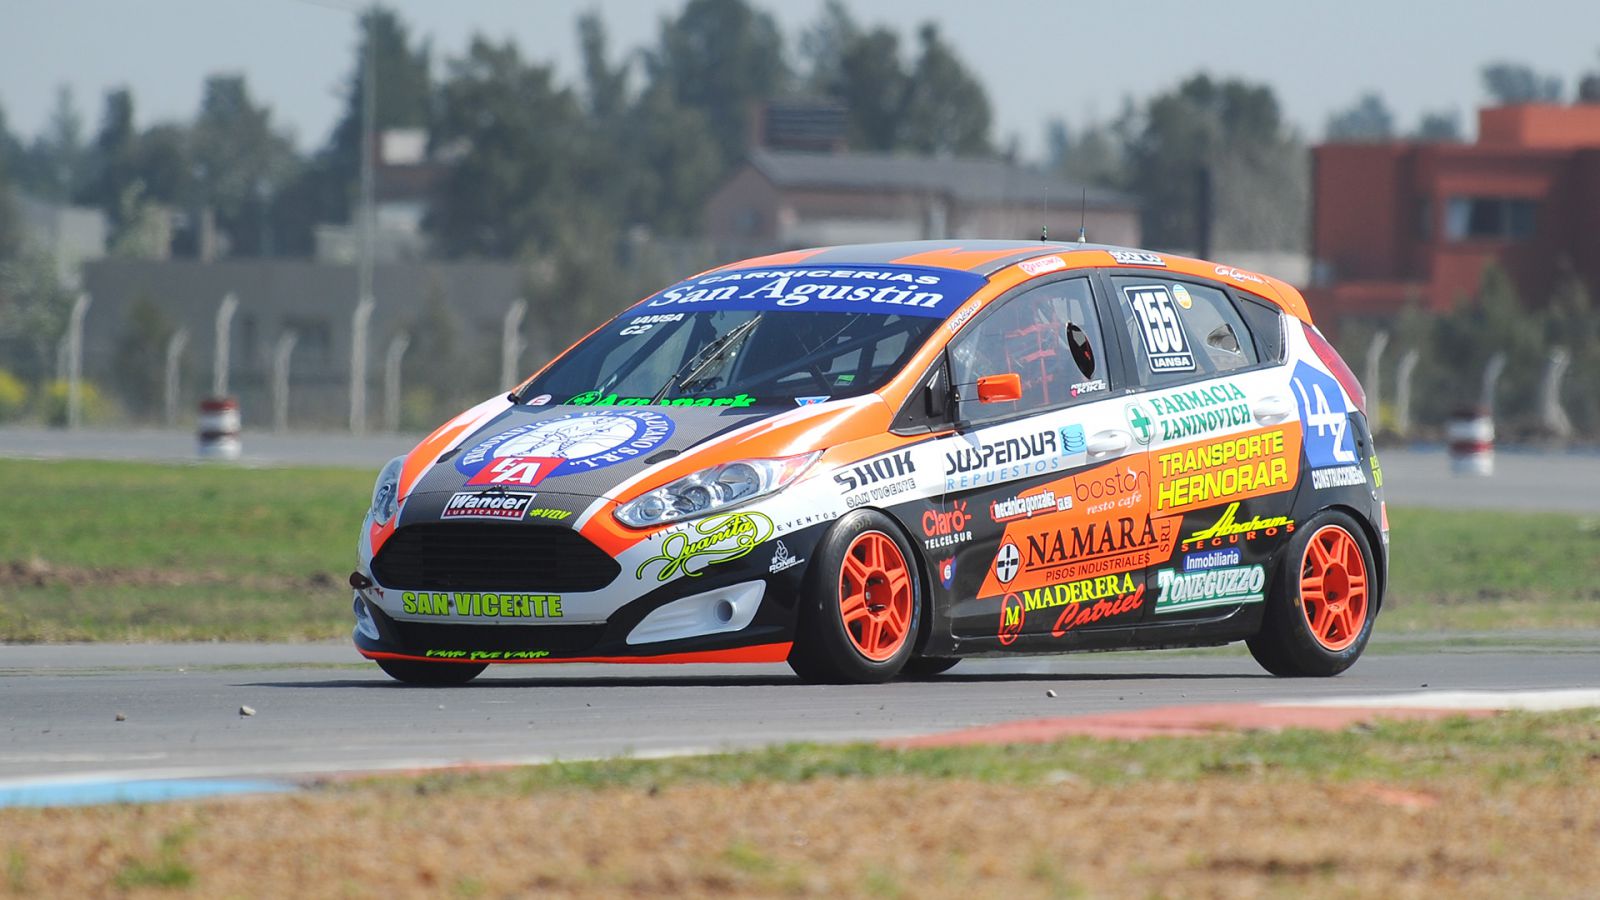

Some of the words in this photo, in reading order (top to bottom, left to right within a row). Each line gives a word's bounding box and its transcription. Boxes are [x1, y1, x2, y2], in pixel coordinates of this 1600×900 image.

[647, 284, 742, 308] San
[739, 276, 944, 309] Agustin
[698, 270, 943, 285] CARNICERIAS
[618, 325, 652, 337] C2
[630, 312, 685, 325] IANSA
[1132, 290, 1184, 353] 155
[1153, 356, 1191, 369] IANSA
[1150, 382, 1248, 416] FARMACIA
[1161, 403, 1252, 442] ZANINOVICH
[945, 430, 1057, 476] SUSPENSUR
[1158, 430, 1285, 478] TRANSPORTE
[833, 450, 916, 495] SHOK
[946, 457, 1060, 491] REPUESTOS
[1073, 466, 1151, 502] boston
[1157, 457, 1289, 511] HERNORAR
[449, 494, 527, 511] Wander
[845, 492, 871, 508] SAN
[870, 477, 917, 501] VICENTE
[1086, 498, 1116, 515] resto
[447, 509, 522, 518] LUBRICANTES
[776, 511, 839, 532] EVENTOS
[922, 505, 967, 537] Claro
[1182, 501, 1295, 545] Abraham
[635, 510, 774, 582] Juanita
[645, 521, 697, 541] VILLA
[924, 530, 973, 550] TELCELSUR
[1025, 512, 1159, 568] NAMARA
[1160, 519, 1172, 553] SRL
[1180, 523, 1296, 552] SEGUROS
[1045, 566, 1076, 582] PISOS
[1077, 552, 1152, 575] INDUSTRIALES
[1186, 550, 1240, 570] Inmobiliaria
[1022, 572, 1137, 612] MADERERA
[1156, 565, 1266, 601] TONEGUZZO
[401, 590, 451, 616] SAN
[453, 592, 563, 618] VICENTE
[1051, 583, 1146, 638] Catriel
